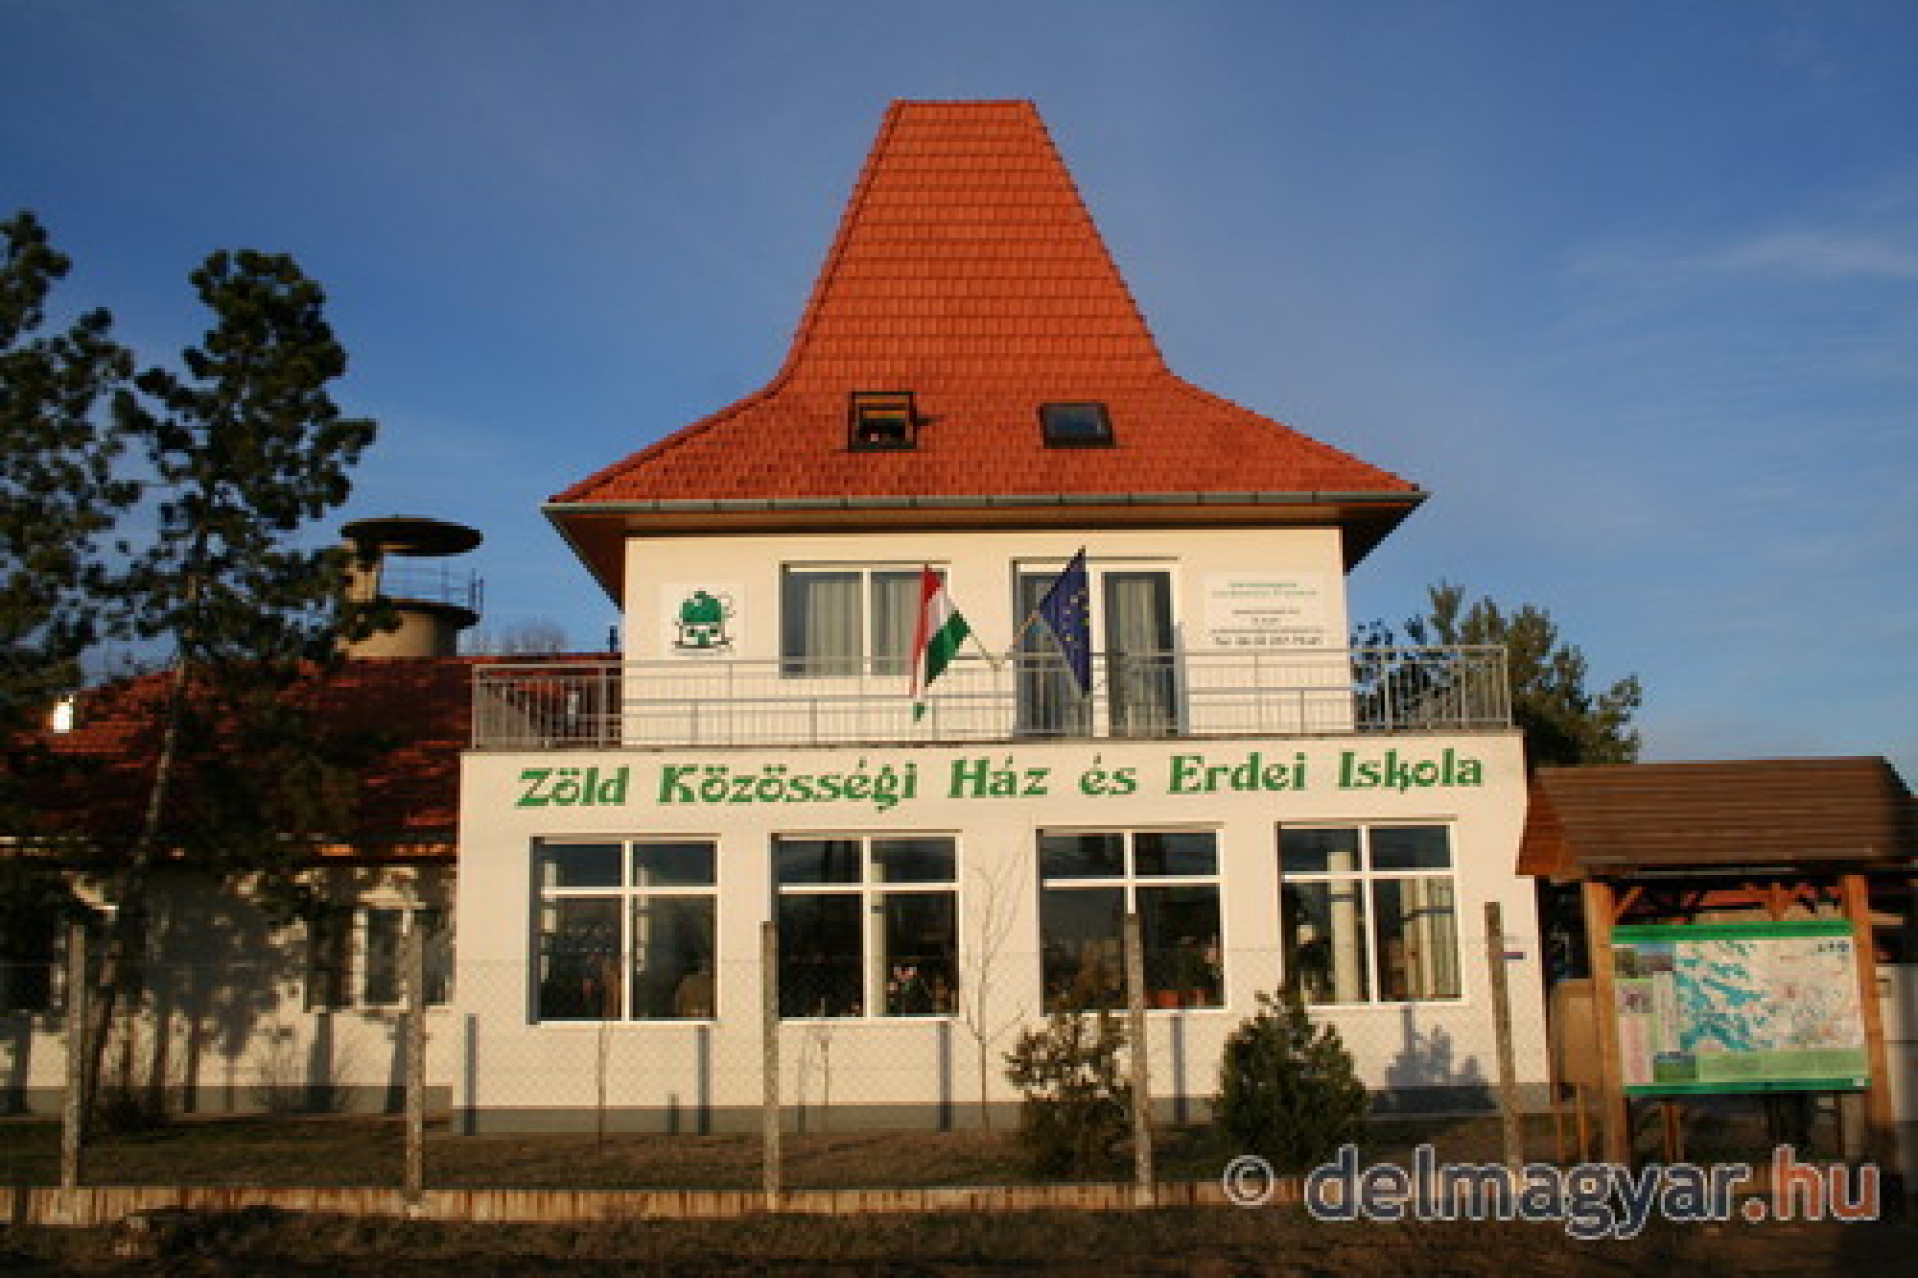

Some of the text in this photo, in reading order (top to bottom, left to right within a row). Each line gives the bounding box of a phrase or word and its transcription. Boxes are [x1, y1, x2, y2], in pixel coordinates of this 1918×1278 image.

[515, 747, 1484, 813] Zöld Közösségi Ház és Erdei Iskola
